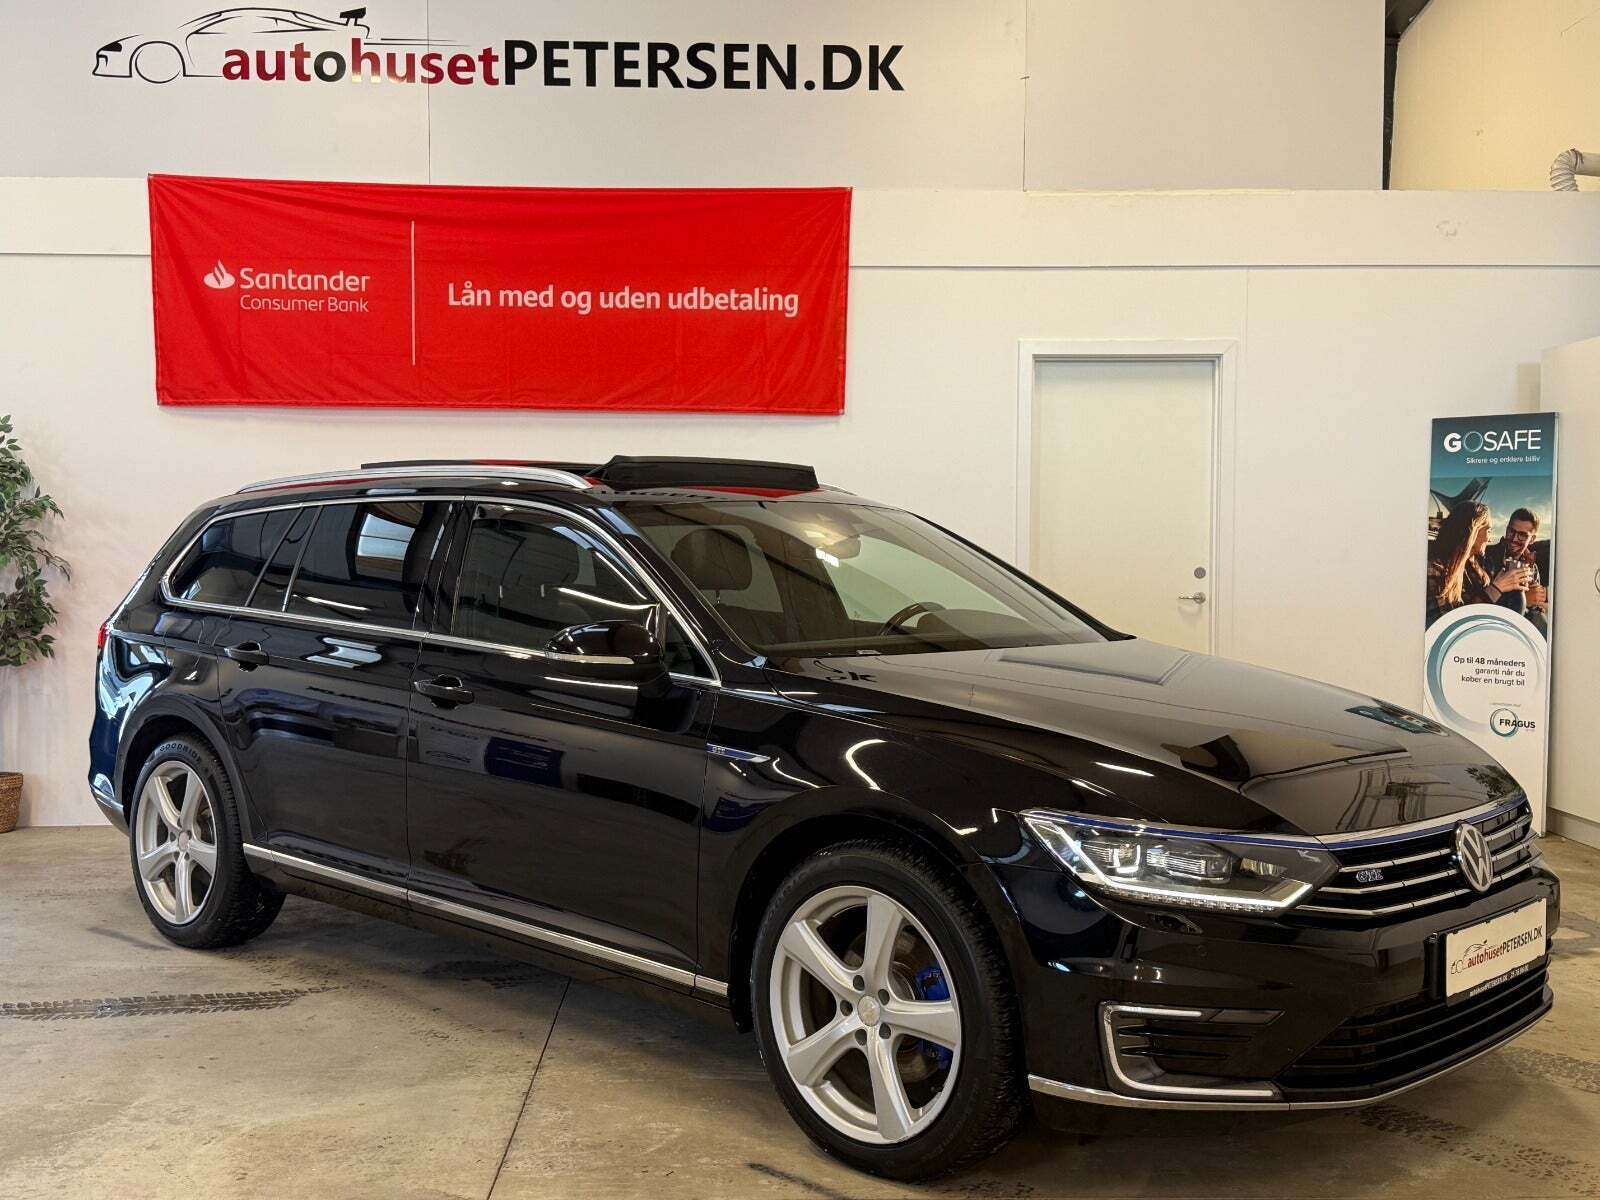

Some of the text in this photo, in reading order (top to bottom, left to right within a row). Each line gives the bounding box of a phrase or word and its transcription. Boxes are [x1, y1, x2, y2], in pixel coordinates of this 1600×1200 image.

[222, 38, 905, 91] autohusetPETERSEN.DK
[239, 267, 370, 292] Santander
[240, 294, 369, 312] Consumer Bank
[448, 280, 799, 318] Lån med og uden udbetaling
[1443, 429, 1542, 453] GOSAFE
[1489, 457, 1498, 465] og
[1453, 655, 1526, 668] Op til 48 måneders
[1475, 668, 1525, 677] garanti når du
[1461, 674, 1482, 683] køber
[1494, 677, 1515, 687] brugt
[1516, 679, 1525, 687] bil
[1499, 717, 1536, 729] FRAGUS
